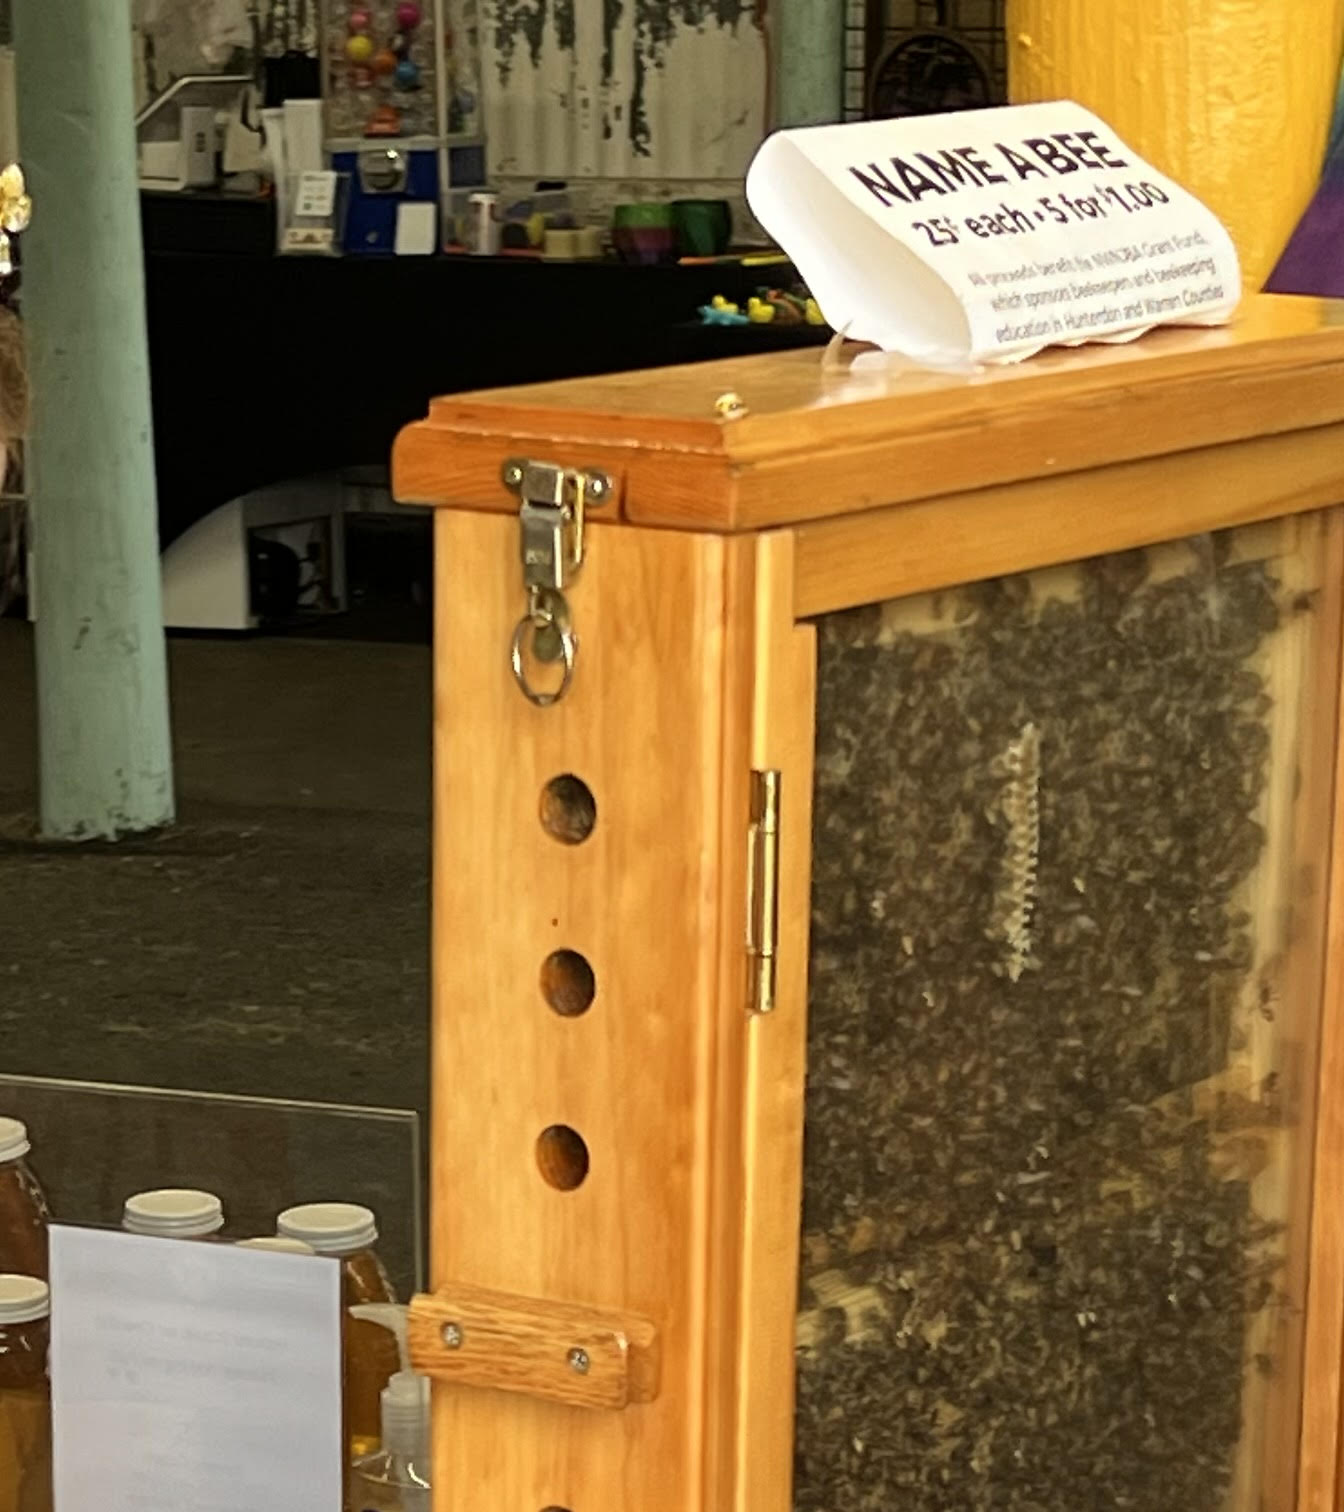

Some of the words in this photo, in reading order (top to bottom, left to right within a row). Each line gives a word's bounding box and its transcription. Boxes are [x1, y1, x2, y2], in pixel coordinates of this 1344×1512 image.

[847, 146, 1008, 207] NAME
[994, 143, 1048, 179] A
[1022, 131, 1129, 175] BEE
[965, 203, 1035, 238] each
[1038, 197, 1068, 223] 5
[1059, 193, 1107, 221] for
[1094, 183, 1170, 212] $1.00
